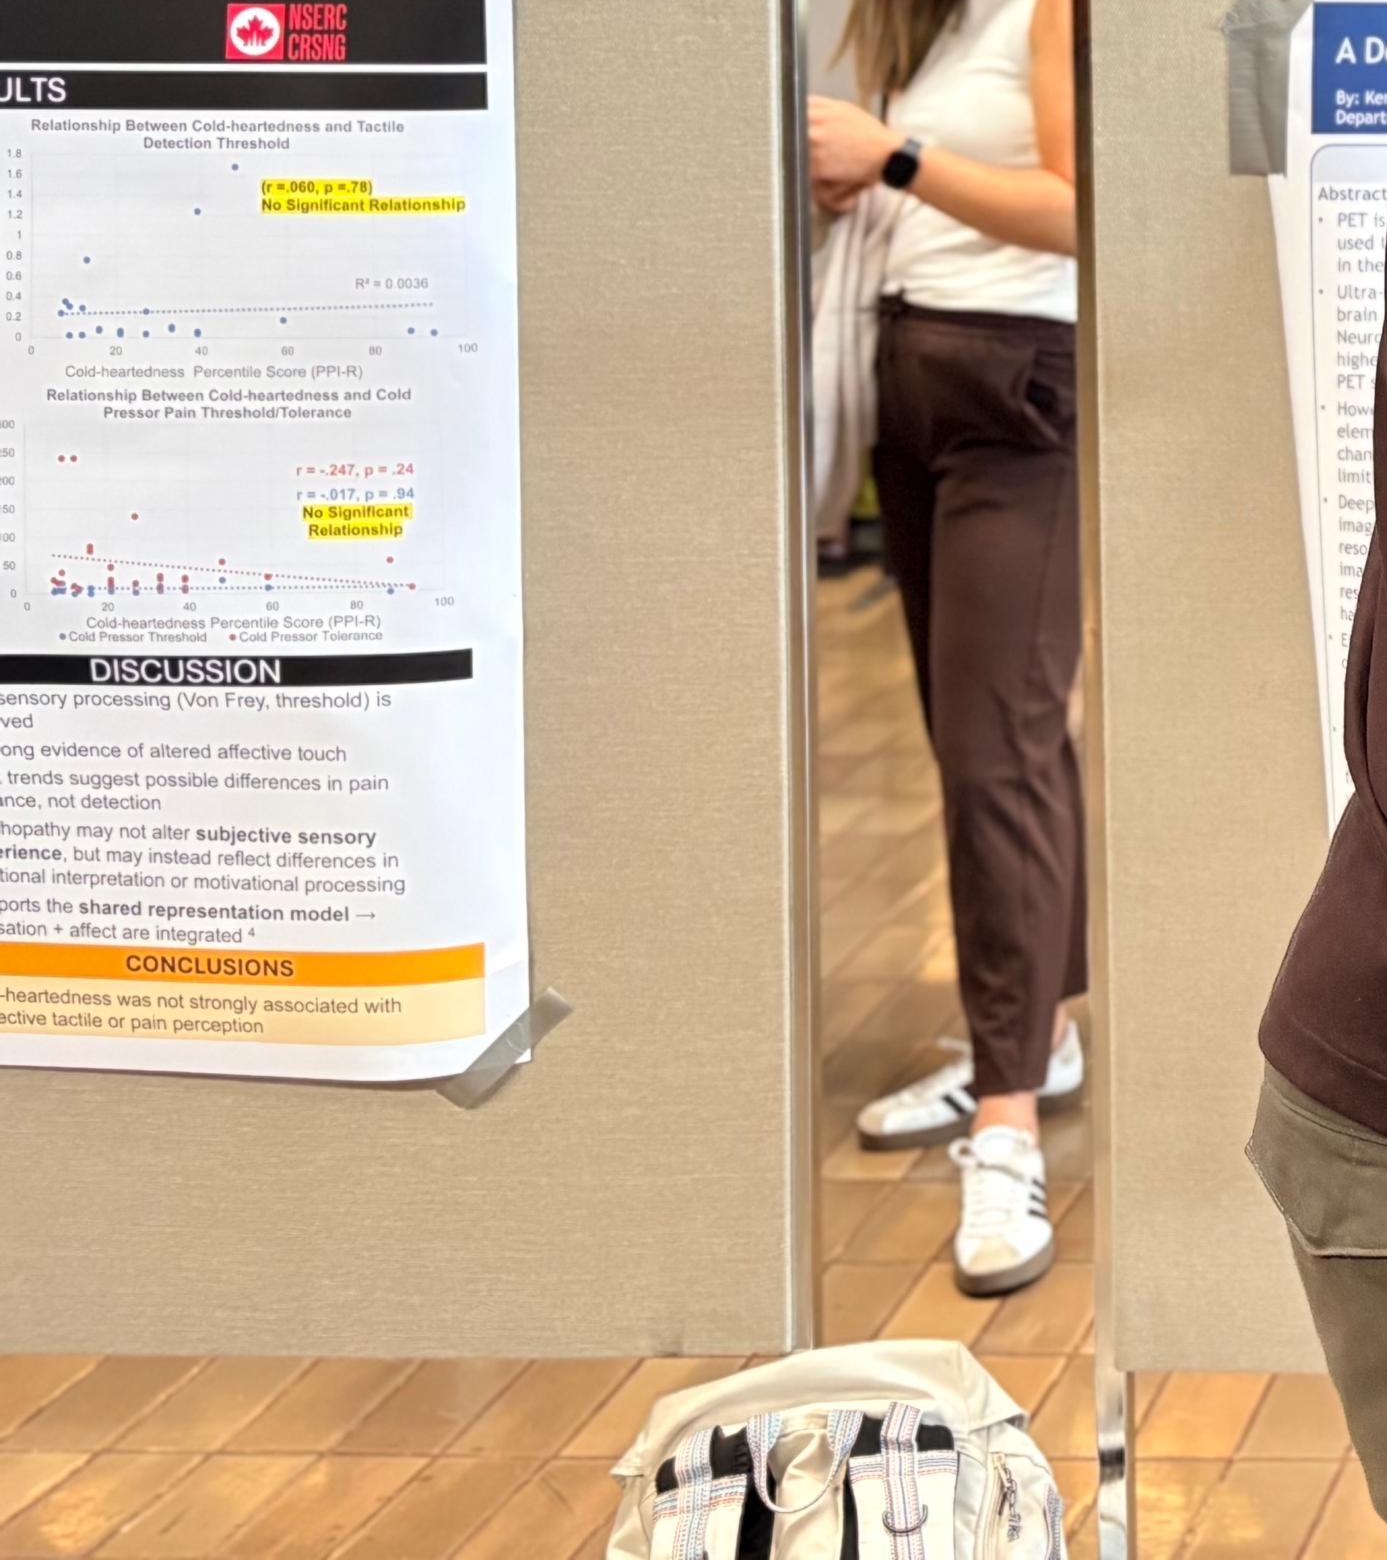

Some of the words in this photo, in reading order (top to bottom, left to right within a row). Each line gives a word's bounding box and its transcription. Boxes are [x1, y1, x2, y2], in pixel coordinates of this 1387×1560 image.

[288, 2, 348, 31] NSERC
[287, 32, 346, 61] CRSNG
[1335, 37, 1356, 63] A
[1335, 90, 1358, 105] By:
[30, 118, 121, 135] Relationship
[124, 118, 188, 134] Between
[191, 118, 321, 134] Cold-heartedness
[324, 120, 352, 133] and
[356, 119, 405, 133] Tactile
[142, 135, 212, 150] Detection
[215, 136, 290, 150] Threshold
[1317, 186, 1387, 201] Abstract
[261, 197, 282, 212] No
[285, 197, 365, 214] Significant
[368, 197, 466, 213] Relationship
[64, 364, 185, 378] Cold-heartedness
[192, 364, 262, 379] Percentile
[265, 364, 307, 379] Score
[310, 364, 364, 381] (PPI-R)
[46, 387, 137, 404] Relationship
[141, 388, 204, 402] Between
[207, 388, 339, 402] Cold-heartedness
[343, 388, 372, 401] and
[375, 387, 412, 401] Cold
[103, 405, 161, 419] Pressor
[164, 405, 196, 419] Pain
[200, 405, 352, 419] Threshold/Tolerance
[302, 505, 324, 519] No
[327, 504, 409, 521] Significant
[308, 522, 403, 538] Relationship
[89, 658, 282, 684] DISCUSSION
[40, 741, 122, 758] evidence
[126, 741, 144, 759] of
[149, 742, 212, 759] altered
[216, 743, 292, 761] affective
[297, 744, 347, 762] touch
[6, 769, 64, 786] trends
[68, 771, 140, 789] suggest
[144, 771, 219, 790] possible
[223, 772, 322, 791] differences
[326, 774, 343, 791] in
[348, 774, 389, 794] pain
[125, 954, 294, 977] CONCLUSIONS
[116, 994, 152, 1008] was
[156, 993, 185, 1009] not
[188, 994, 258, 1015] strongly
[262, 996, 359, 1014] associated
[363, 996, 402, 1014] with
